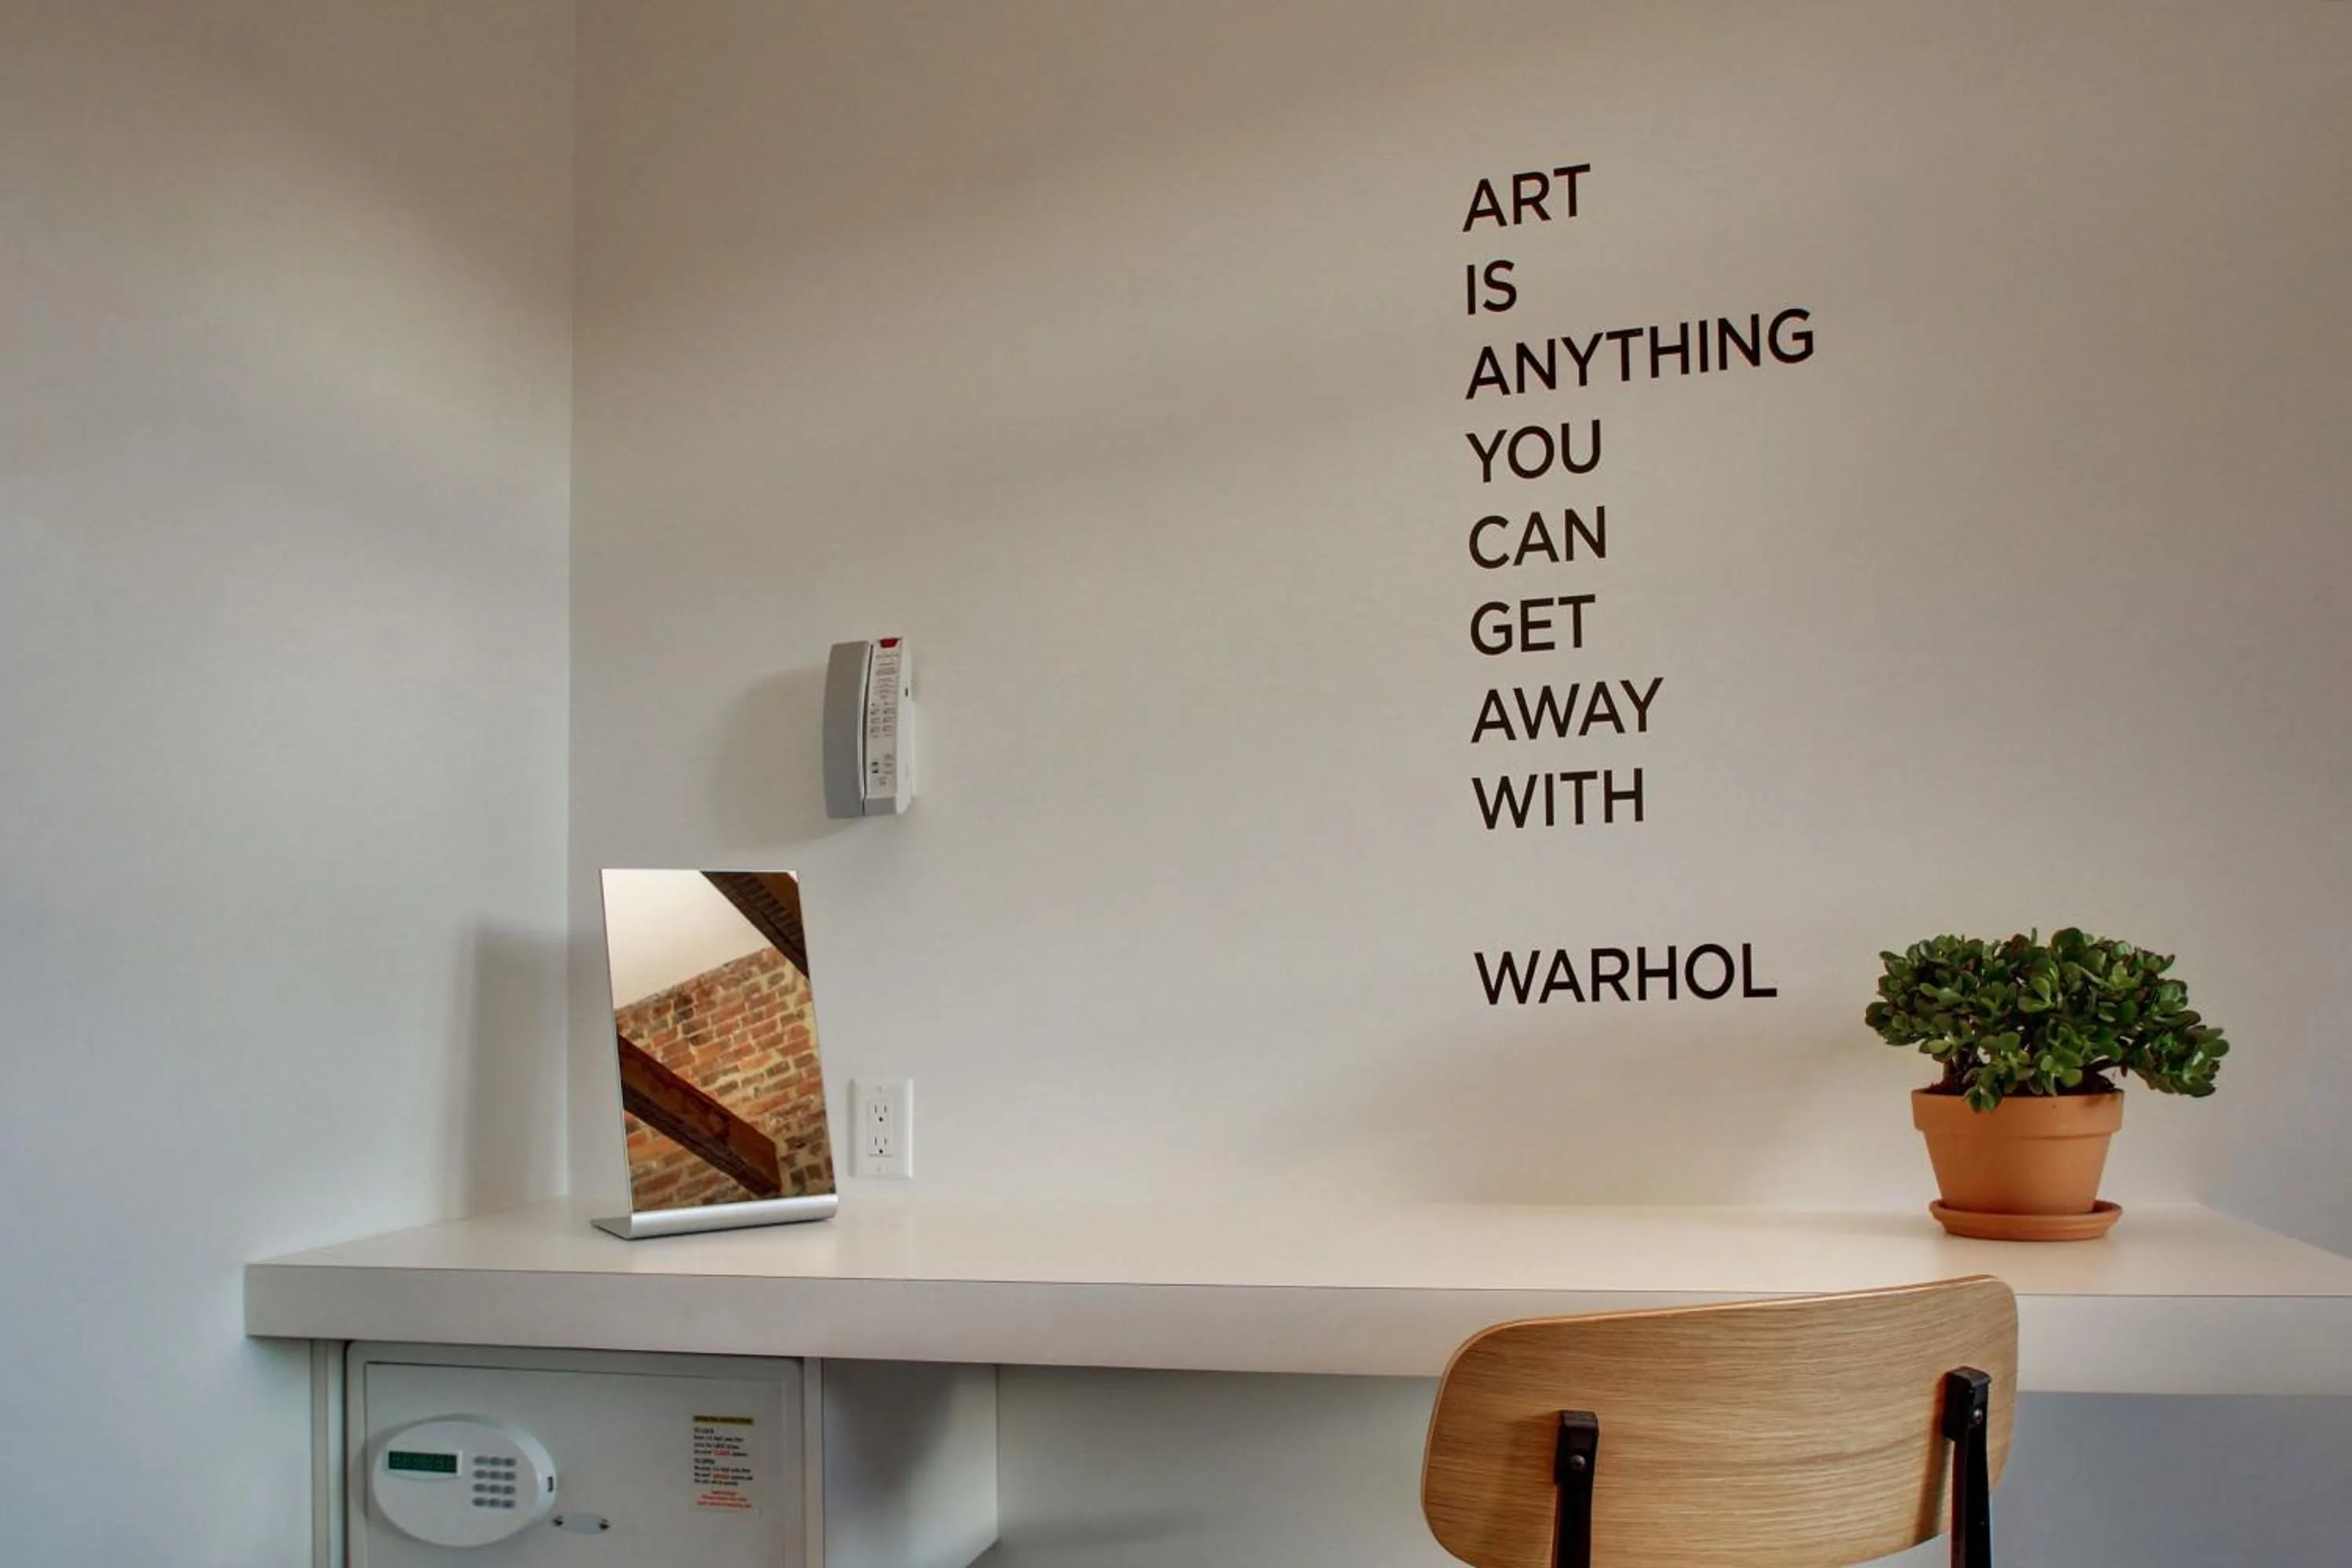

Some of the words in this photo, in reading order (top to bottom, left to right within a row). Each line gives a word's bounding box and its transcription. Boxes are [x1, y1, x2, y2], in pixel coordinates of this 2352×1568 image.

[1463, 163, 1591, 232] ART
[1467, 260, 1517, 315] IS
[1465, 308, 1814, 400] ANYTHING
[1465, 419, 1601, 483] YOU
[1469, 506, 1606, 569] CAN
[1470, 594, 1595, 655] GET
[1471, 677, 1664, 743] AWAY
[1472, 768, 1644, 829] WITH
[1474, 942, 1777, 1005] WARHOL
